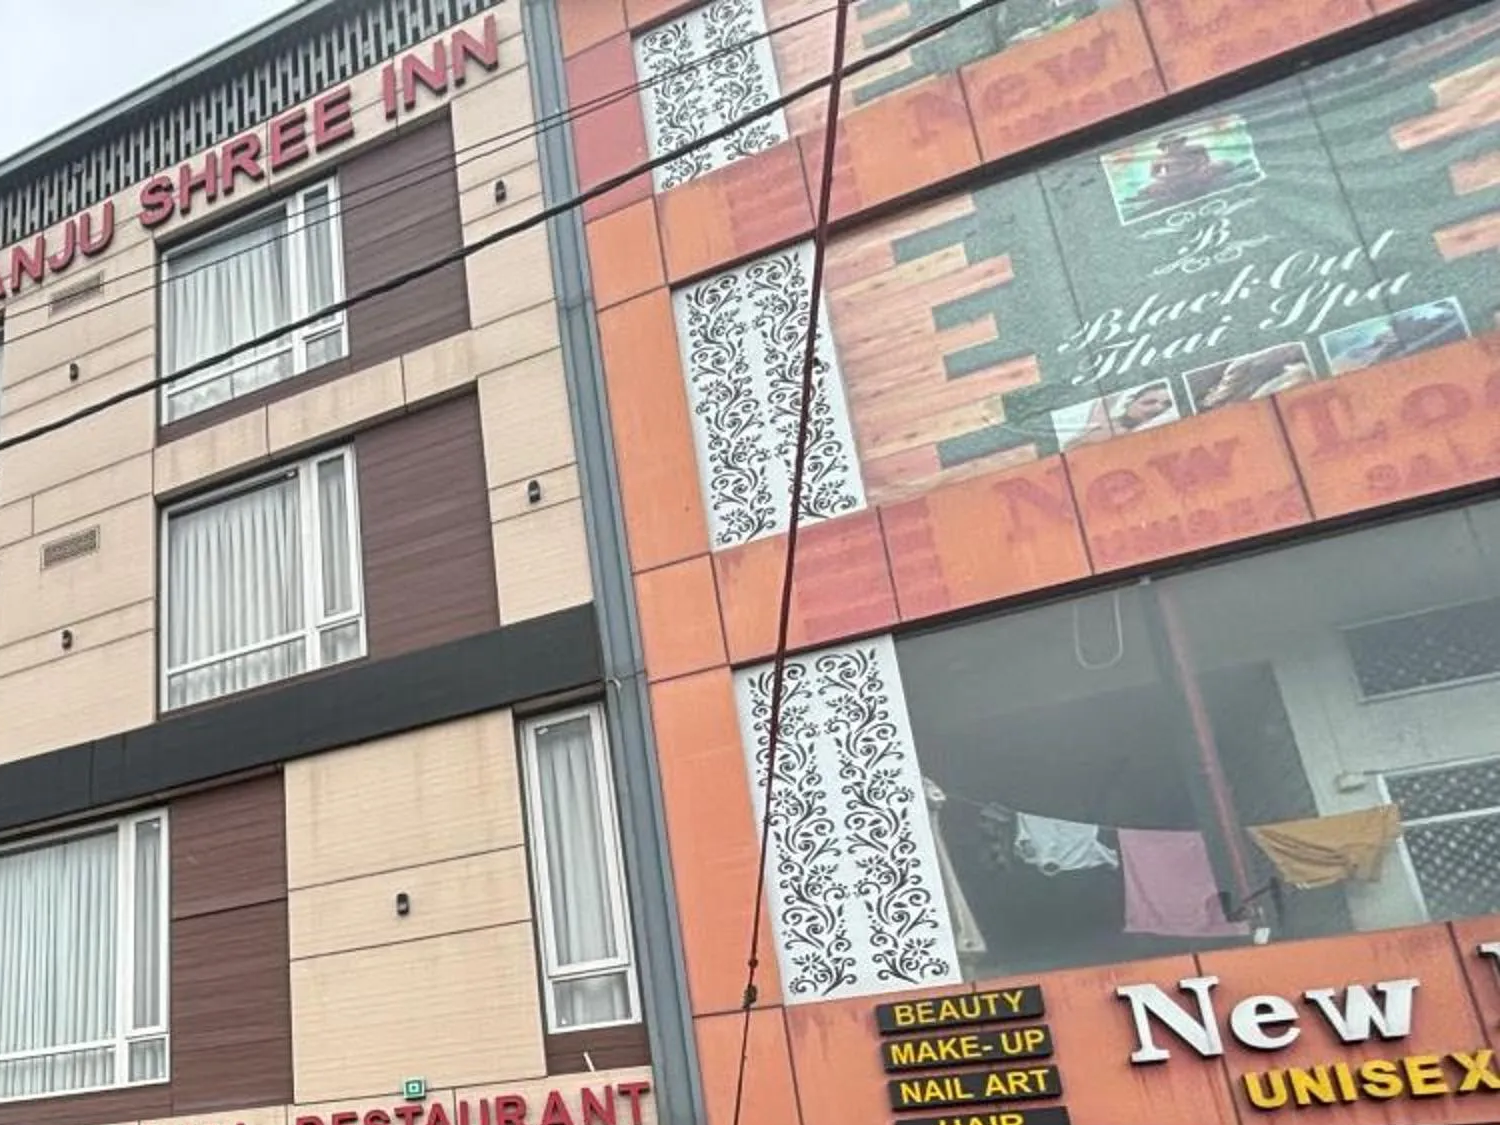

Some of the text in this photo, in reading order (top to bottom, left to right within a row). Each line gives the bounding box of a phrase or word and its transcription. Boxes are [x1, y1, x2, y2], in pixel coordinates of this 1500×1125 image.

[137, 86, 354, 228] SHREE
[381, 15, 499, 119] INN
[1057, 265, 1260, 353] Black
[1071, 272, 1412, 386] Thai Spa
[894, 990, 1024, 1028] BEAUTY
[1001, 1029, 1045, 1057] UP
[1116, 975, 1420, 1065] New
[899, 1069, 1050, 1105] NAIL ART
[1242, 1048, 1500, 1111] UNISEX
